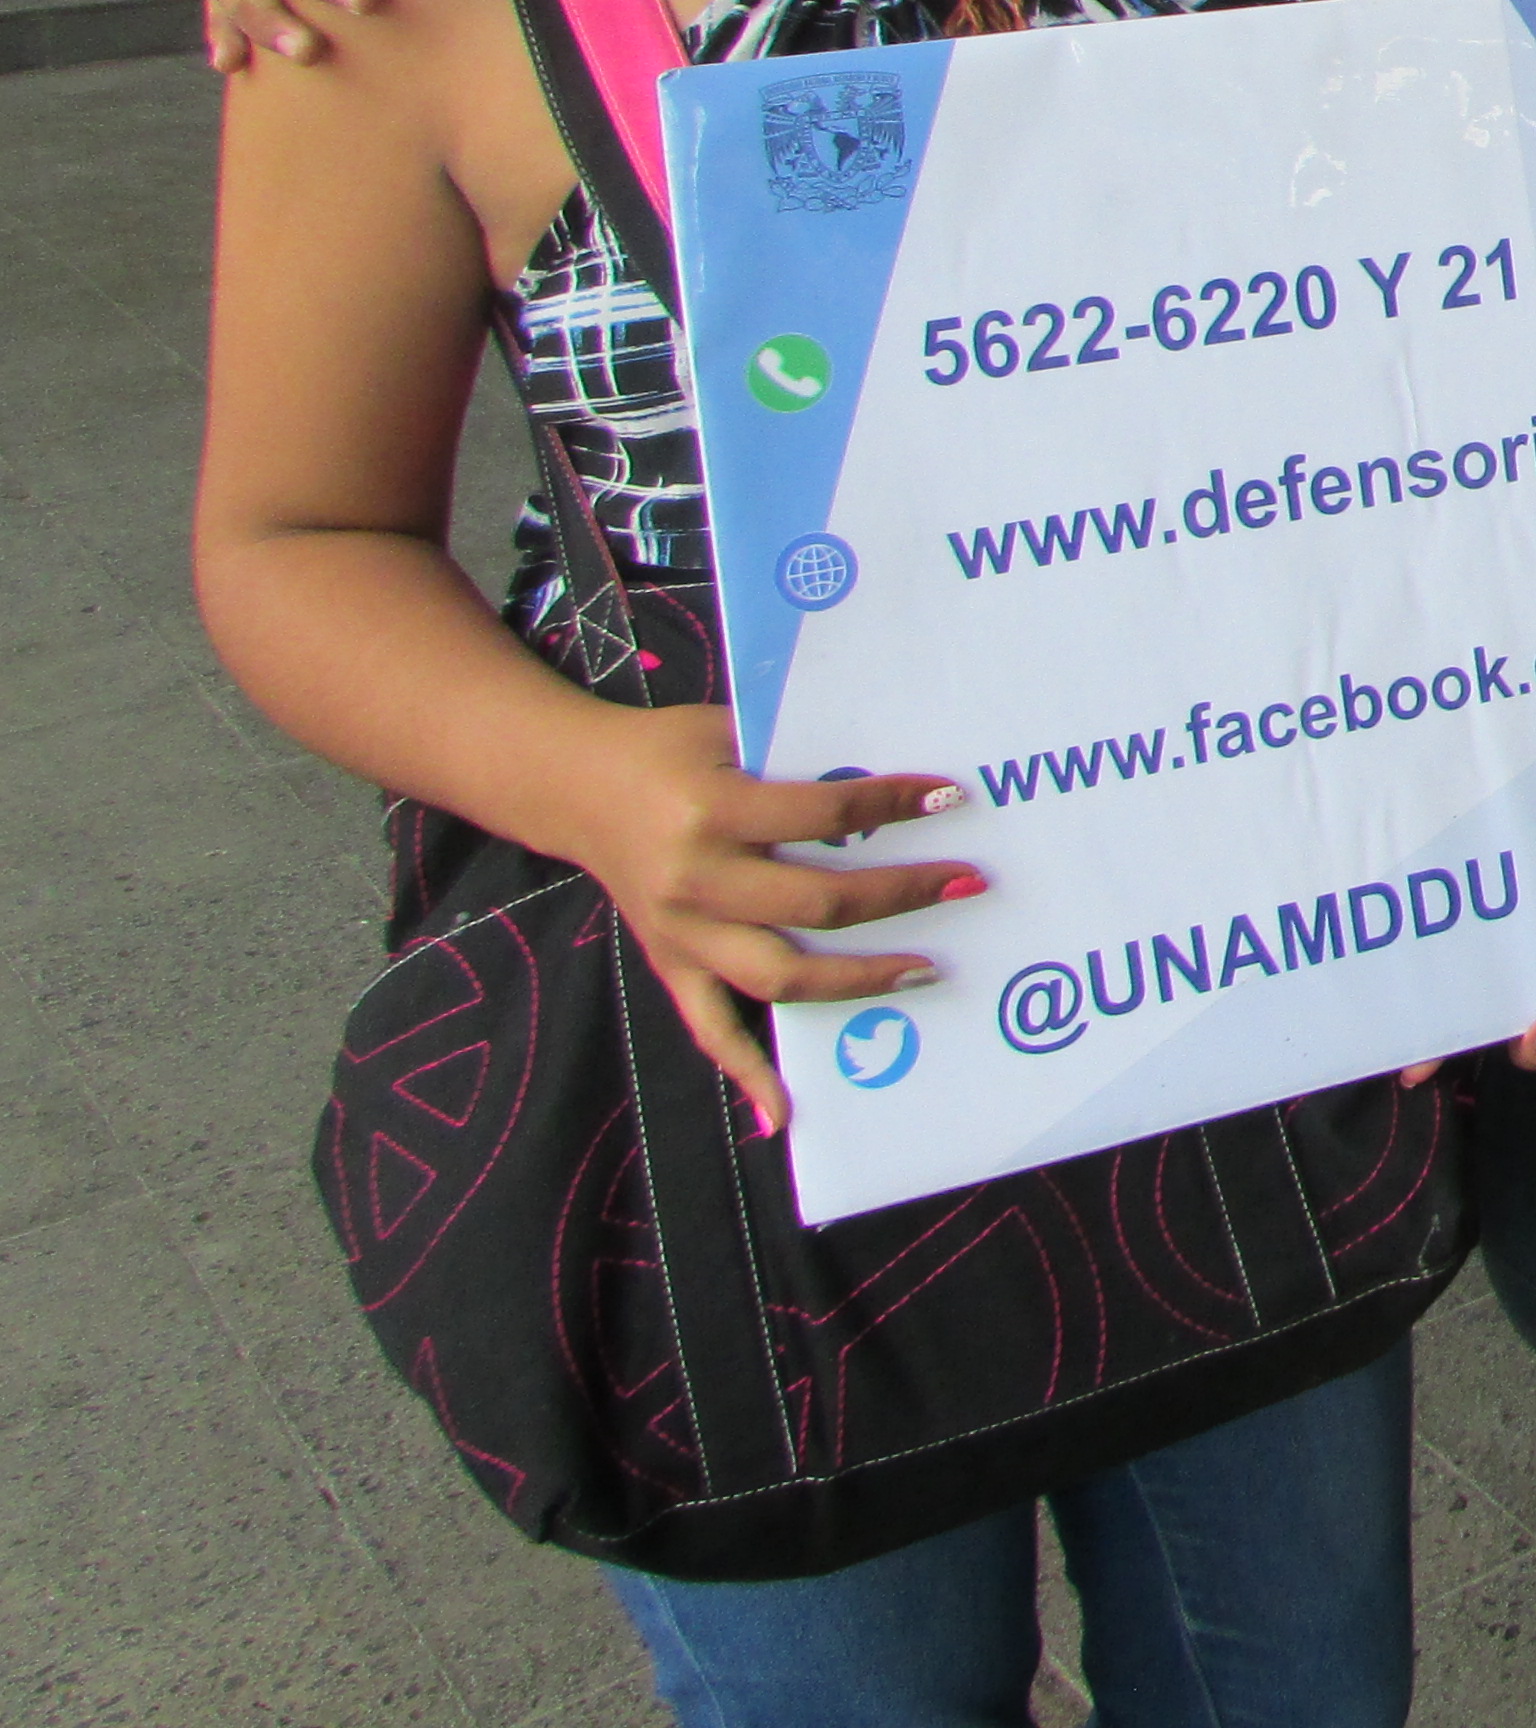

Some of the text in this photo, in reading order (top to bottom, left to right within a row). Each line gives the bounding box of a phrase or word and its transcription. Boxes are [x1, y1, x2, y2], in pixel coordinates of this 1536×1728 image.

[924, 238, 1519, 386] 5622-6220 Y 21
[999, 850, 1519, 1055] @UNAMDDU
